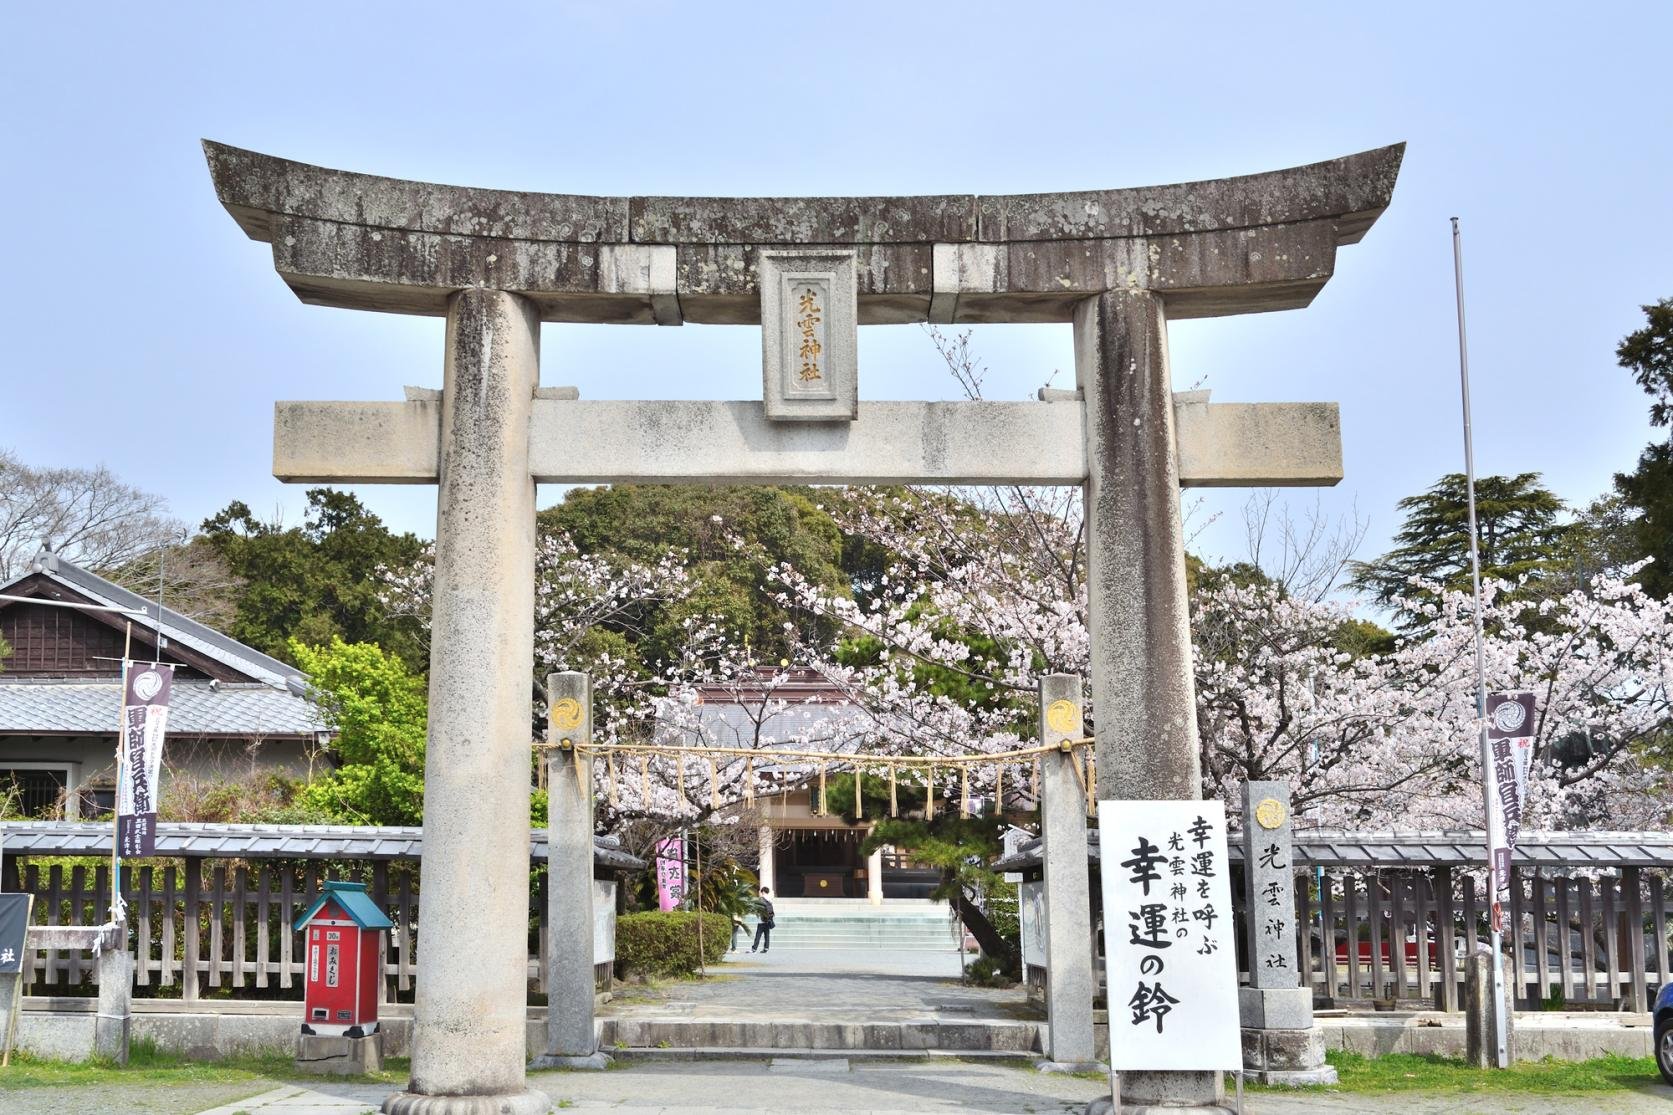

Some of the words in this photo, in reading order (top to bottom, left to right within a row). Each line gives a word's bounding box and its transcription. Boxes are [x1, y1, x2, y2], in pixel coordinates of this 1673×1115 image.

[798, 288, 821, 382] 光雲神社
[128, 706, 150, 814] 軍師官兵衛
[1519, 739, 1530, 748] 祝
[1121, 836, 1181, 1034] 幸運の鈴
[1167, 831, 1189, 938] 光雲神社の
[1187, 815, 1218, 955] 幸運を呼ぶ
[1259, 843, 1287, 968] 光雲神社
[329, 946, 337, 985] おみくじ
